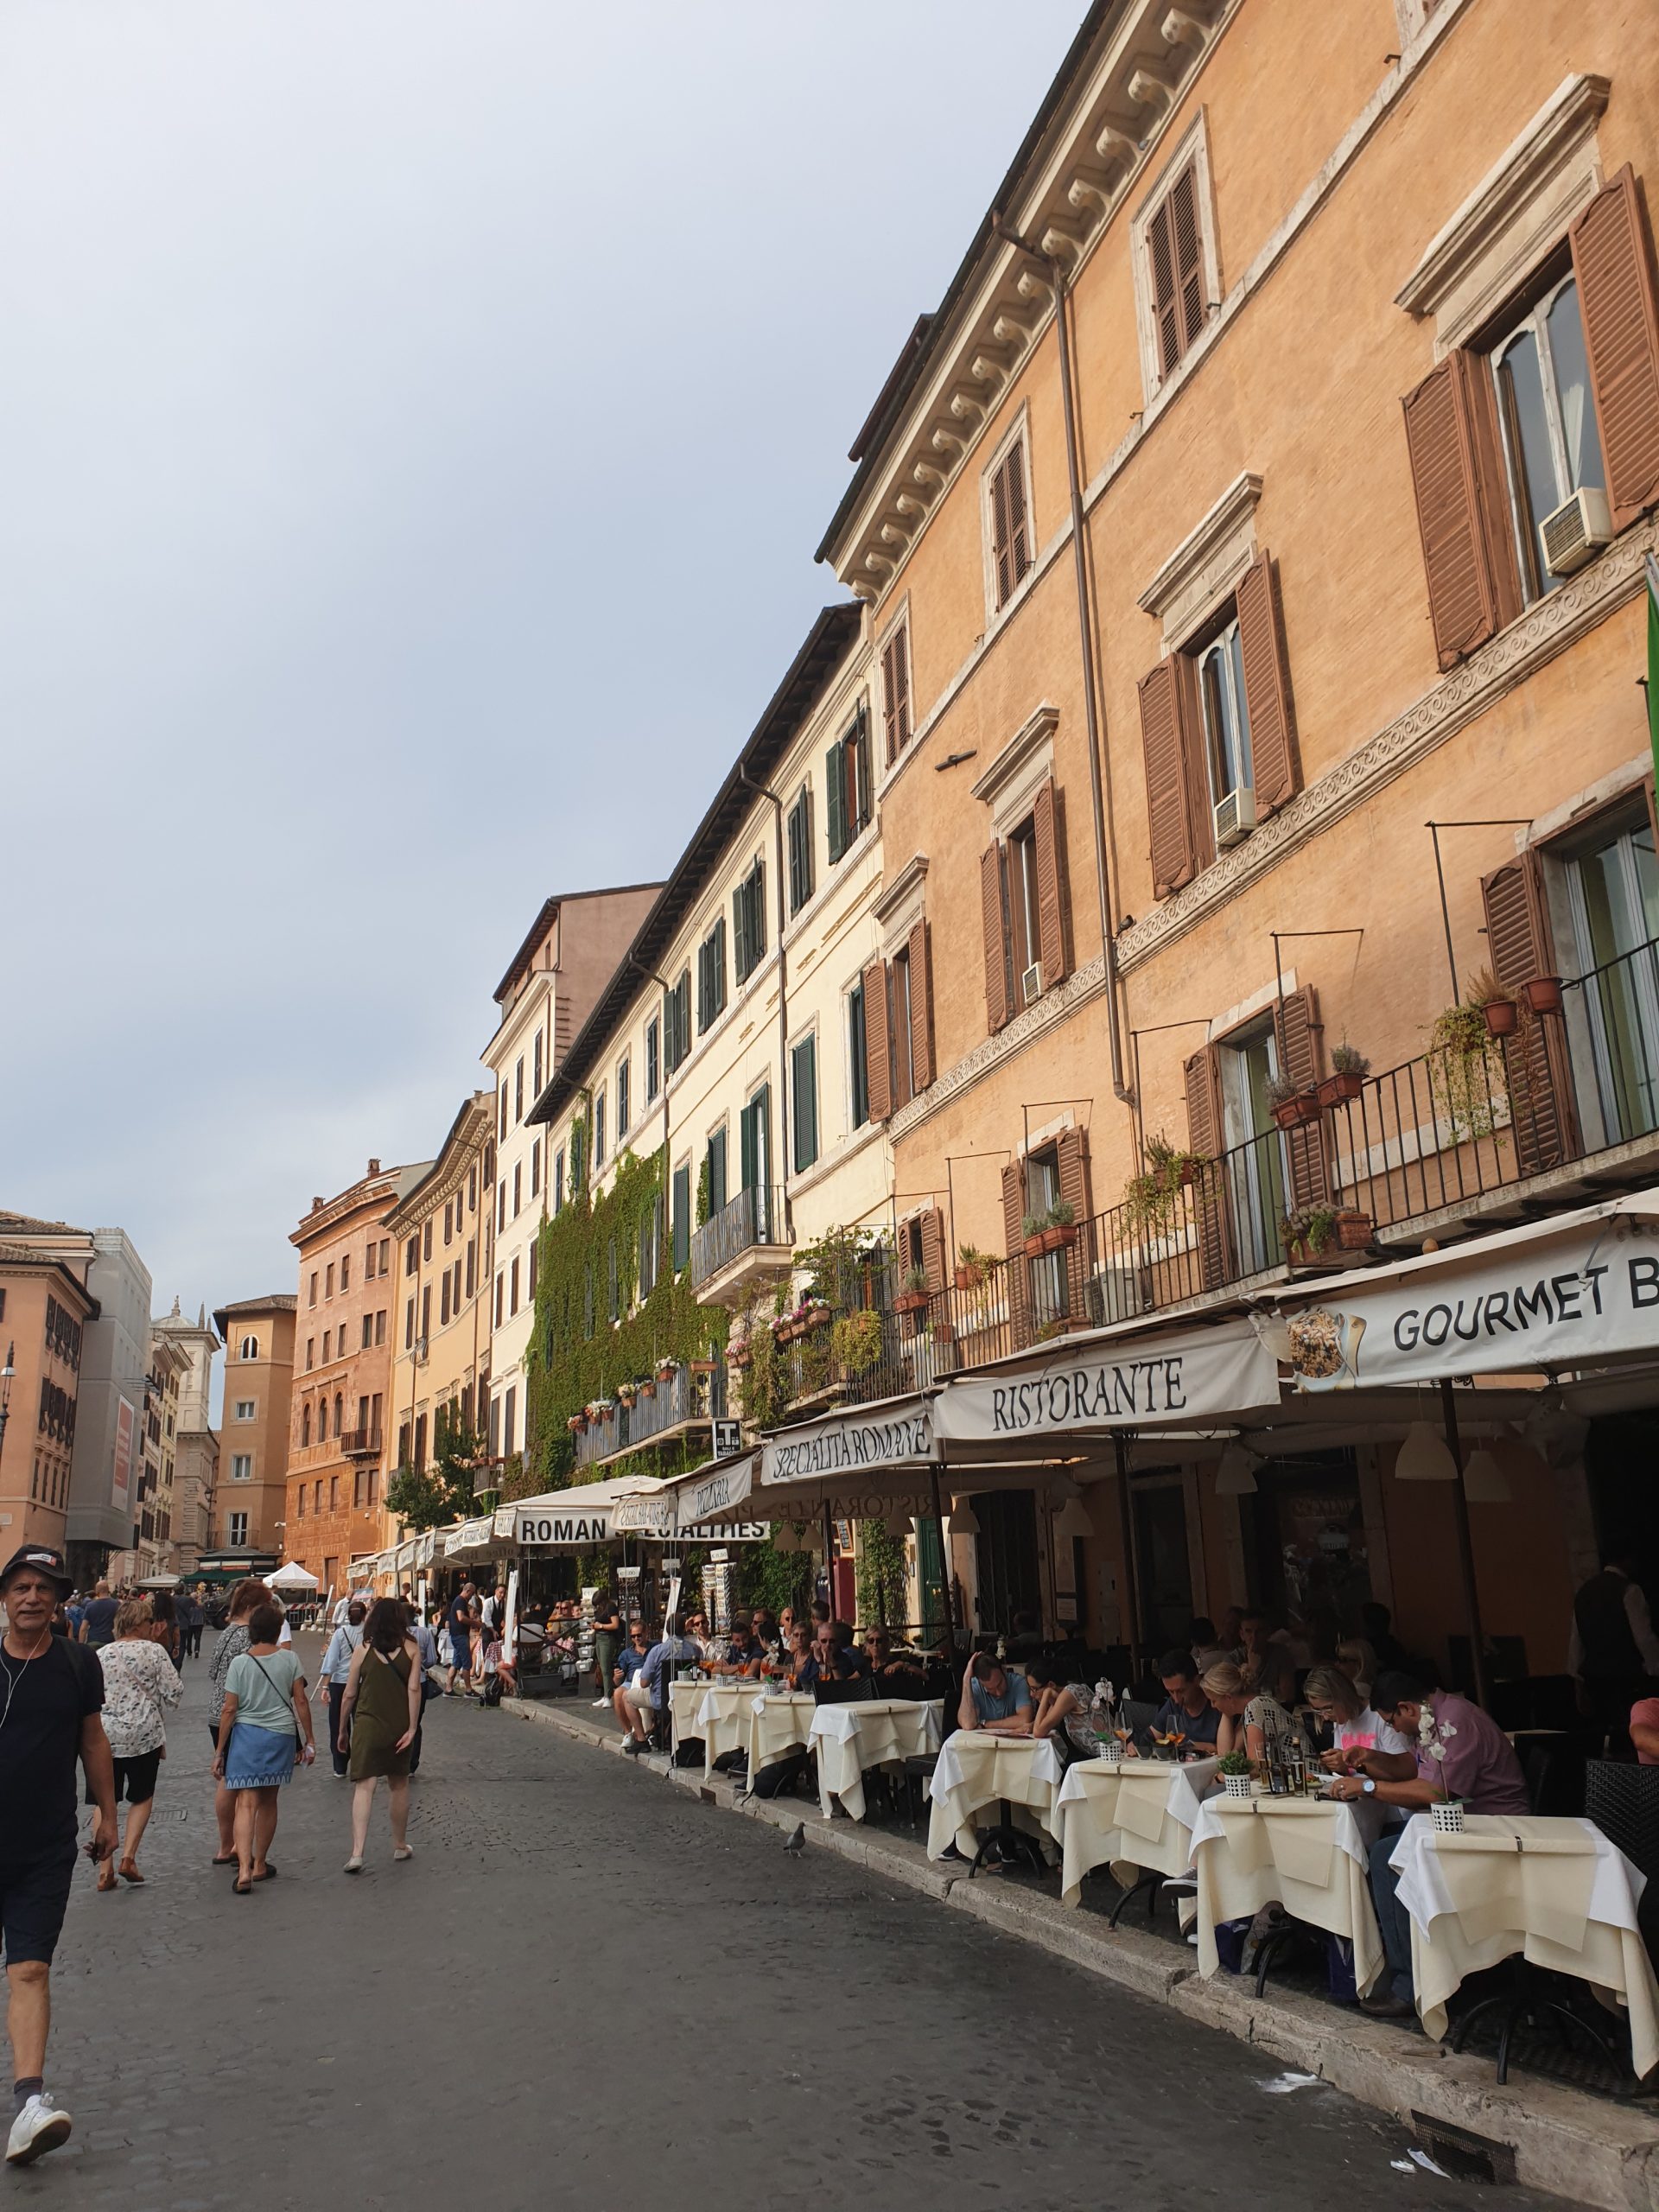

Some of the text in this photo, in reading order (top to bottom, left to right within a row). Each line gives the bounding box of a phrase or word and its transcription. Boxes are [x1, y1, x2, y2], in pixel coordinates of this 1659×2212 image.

[1393, 1265, 1609, 1351] GOURMET
[992, 1356, 1187, 1432] RISTORANTE
[718, 1422, 736, 1446] T
[772, 1415, 931, 1478] SPECIALITÀ ROMANE
[696, 1476, 731, 1516] PIZZERIA
[522, 1518, 607, 1542] ROMAN
